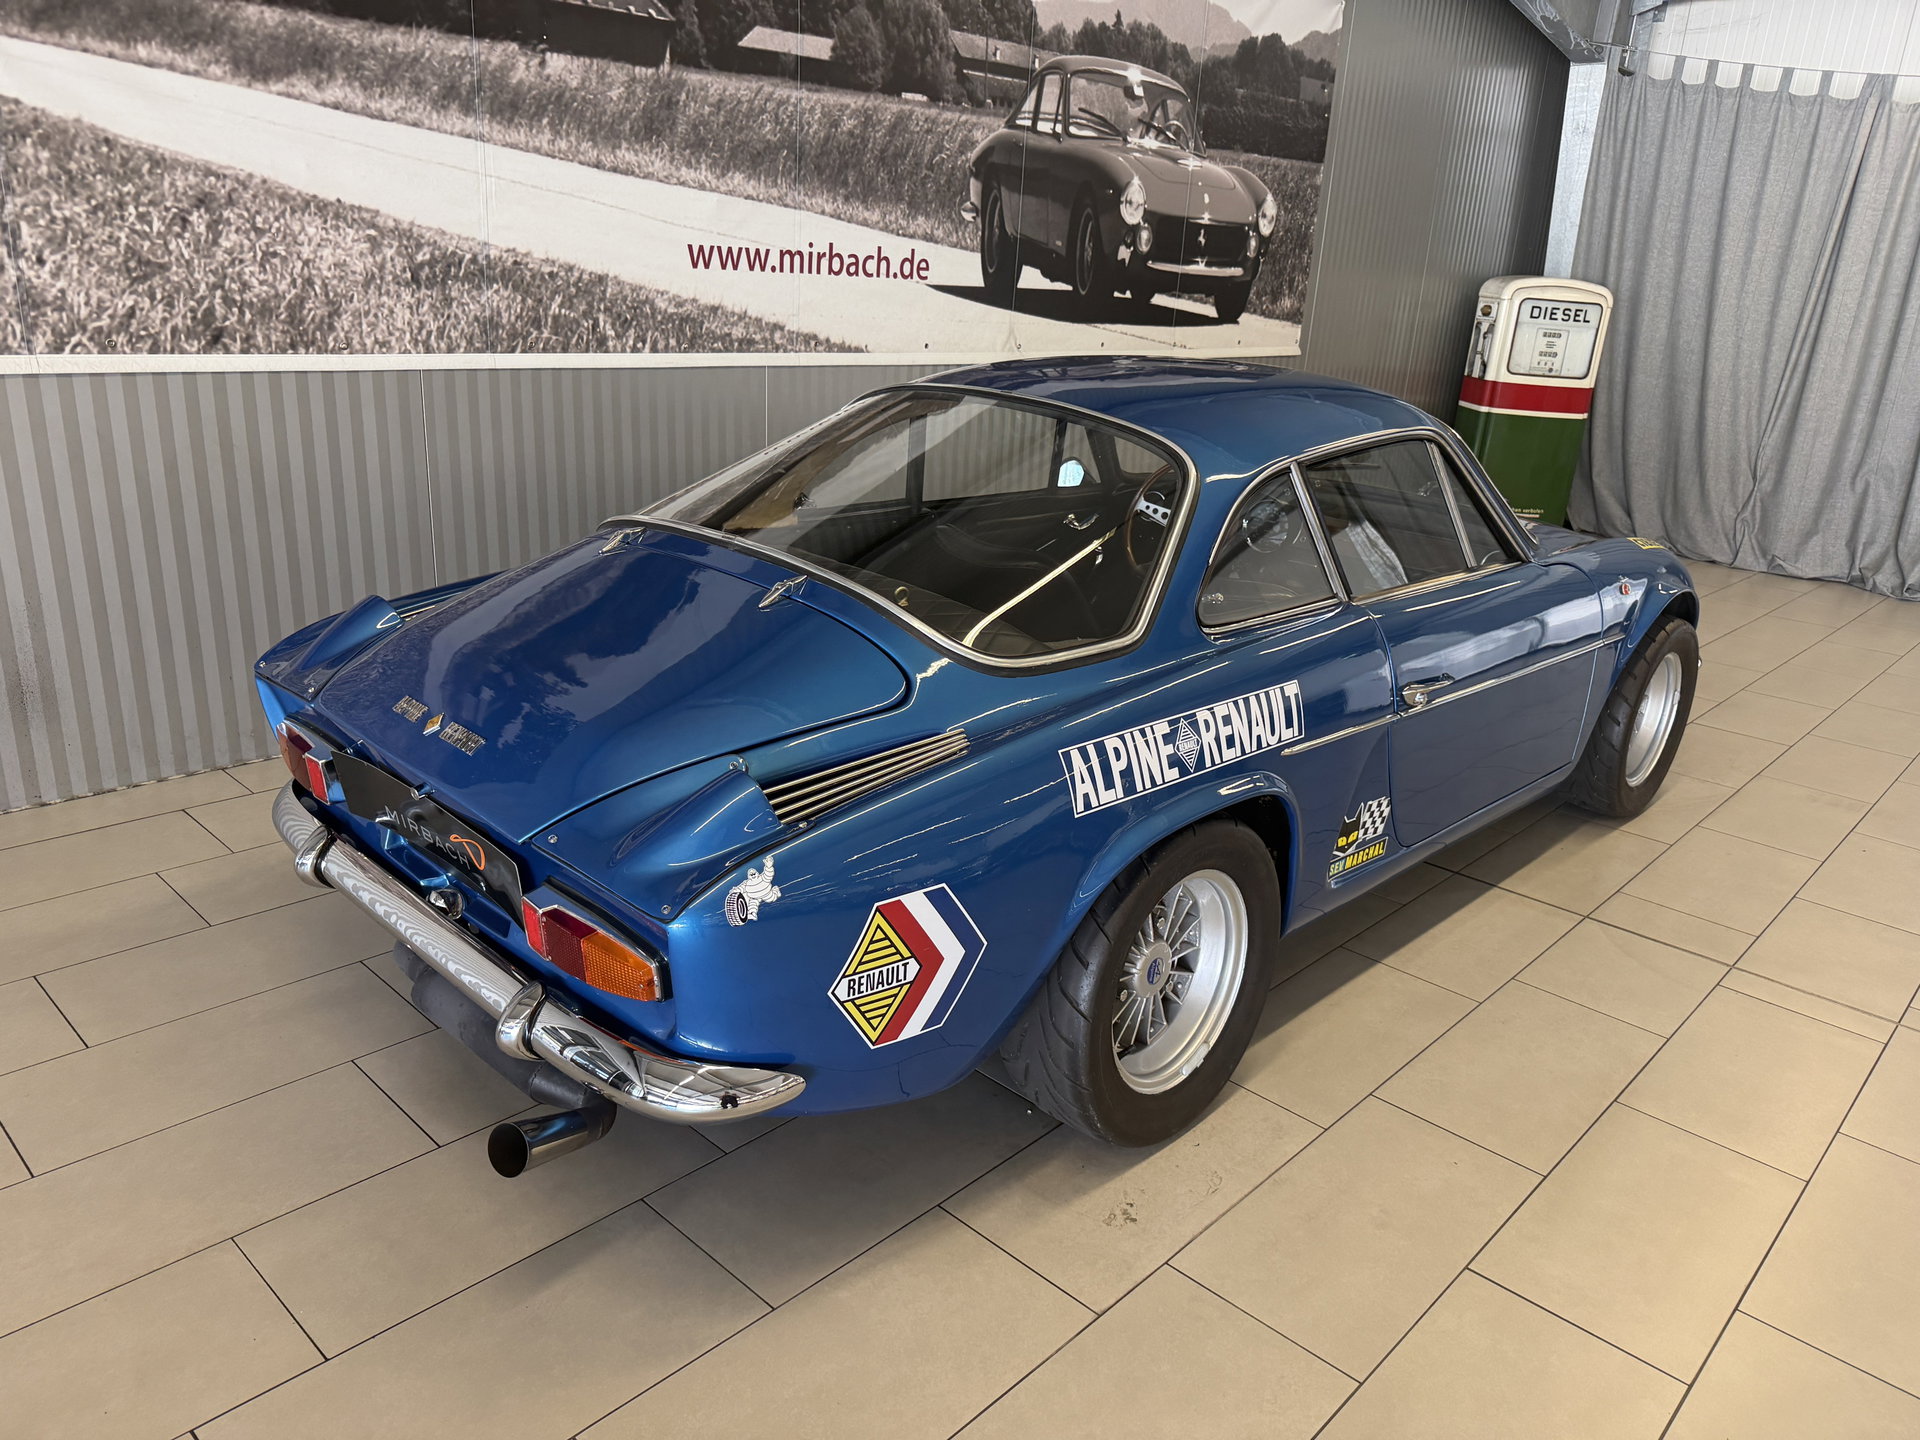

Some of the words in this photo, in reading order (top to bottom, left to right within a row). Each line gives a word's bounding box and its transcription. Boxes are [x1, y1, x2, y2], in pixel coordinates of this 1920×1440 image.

[687, 242, 930, 281] www.mirbach.de
[1529, 306, 1591, 324] DIESEL
[1069, 722, 1180, 813] ALPINE
[1195, 684, 1300, 768] RENAULT
[1178, 738, 1198, 753] RENAULT
[384, 805, 471, 870] MIRBACH
[1329, 858, 1346, 876] SEV
[1344, 842, 1385, 870] MARCHAL
[847, 961, 911, 998] RENAULT
